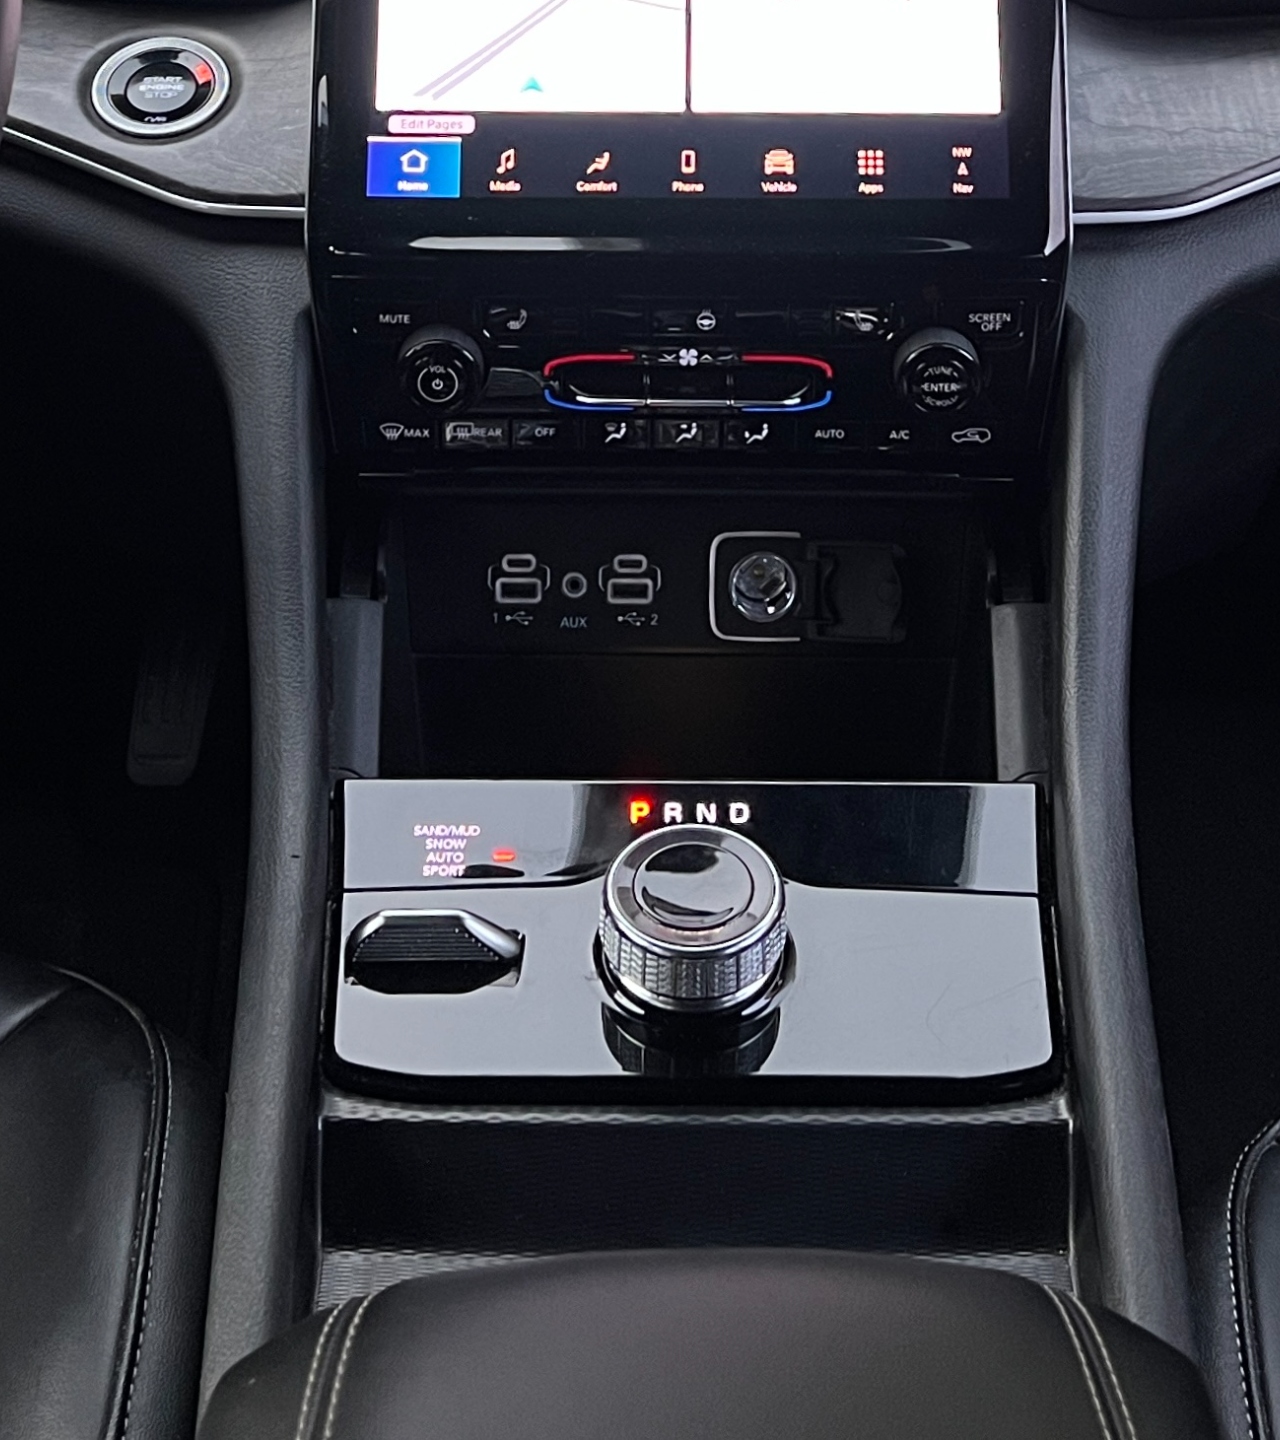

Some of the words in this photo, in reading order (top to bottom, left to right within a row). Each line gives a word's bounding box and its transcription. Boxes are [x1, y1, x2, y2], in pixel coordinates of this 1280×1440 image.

[144, 91, 178, 99] STOP
[401, 118, 424, 130] Edit
[427, 118, 463, 132] Pages
[951, 147, 972, 158] NW
[397, 180, 429, 192] Home
[489, 180, 521, 192] Media
[576, 180, 618, 192] Comfort
[672, 181, 704, 192] Phone
[761, 181, 798, 193] Vehicle
[858, 182, 884, 195] Apps
[952, 182, 974, 194] Nav
[379, 313, 411, 324] MUTE
[968, 312, 1011, 323] SCREEN
[981, 322, 1002, 332] OFF
[428, 365, 446, 374] VOL
[928, 366, 954, 376] TUNE
[924, 382, 958, 393] ENTER
[924, 396, 958, 407] SCROLL
[404, 428, 430, 438] MAX
[473, 427, 502, 438] REAR
[534, 427, 556, 438] OFF
[814, 429, 845, 439] AUTO
[889, 429, 910, 440] A/C
[493, 612, 498, 624] 1
[560, 616, 587, 629] AUX
[650, 613, 658, 626] 2
[630, 800, 650, 824] P
[664, 801, 683, 824] R
[696, 802, 717, 823] N
[729, 801, 750, 824] D
[413, 825, 481, 837] SAND/MUD
[425, 838, 467, 850] SNOW
[426, 852, 465, 863] AUTO
[422, 864, 466, 877] SPORT
